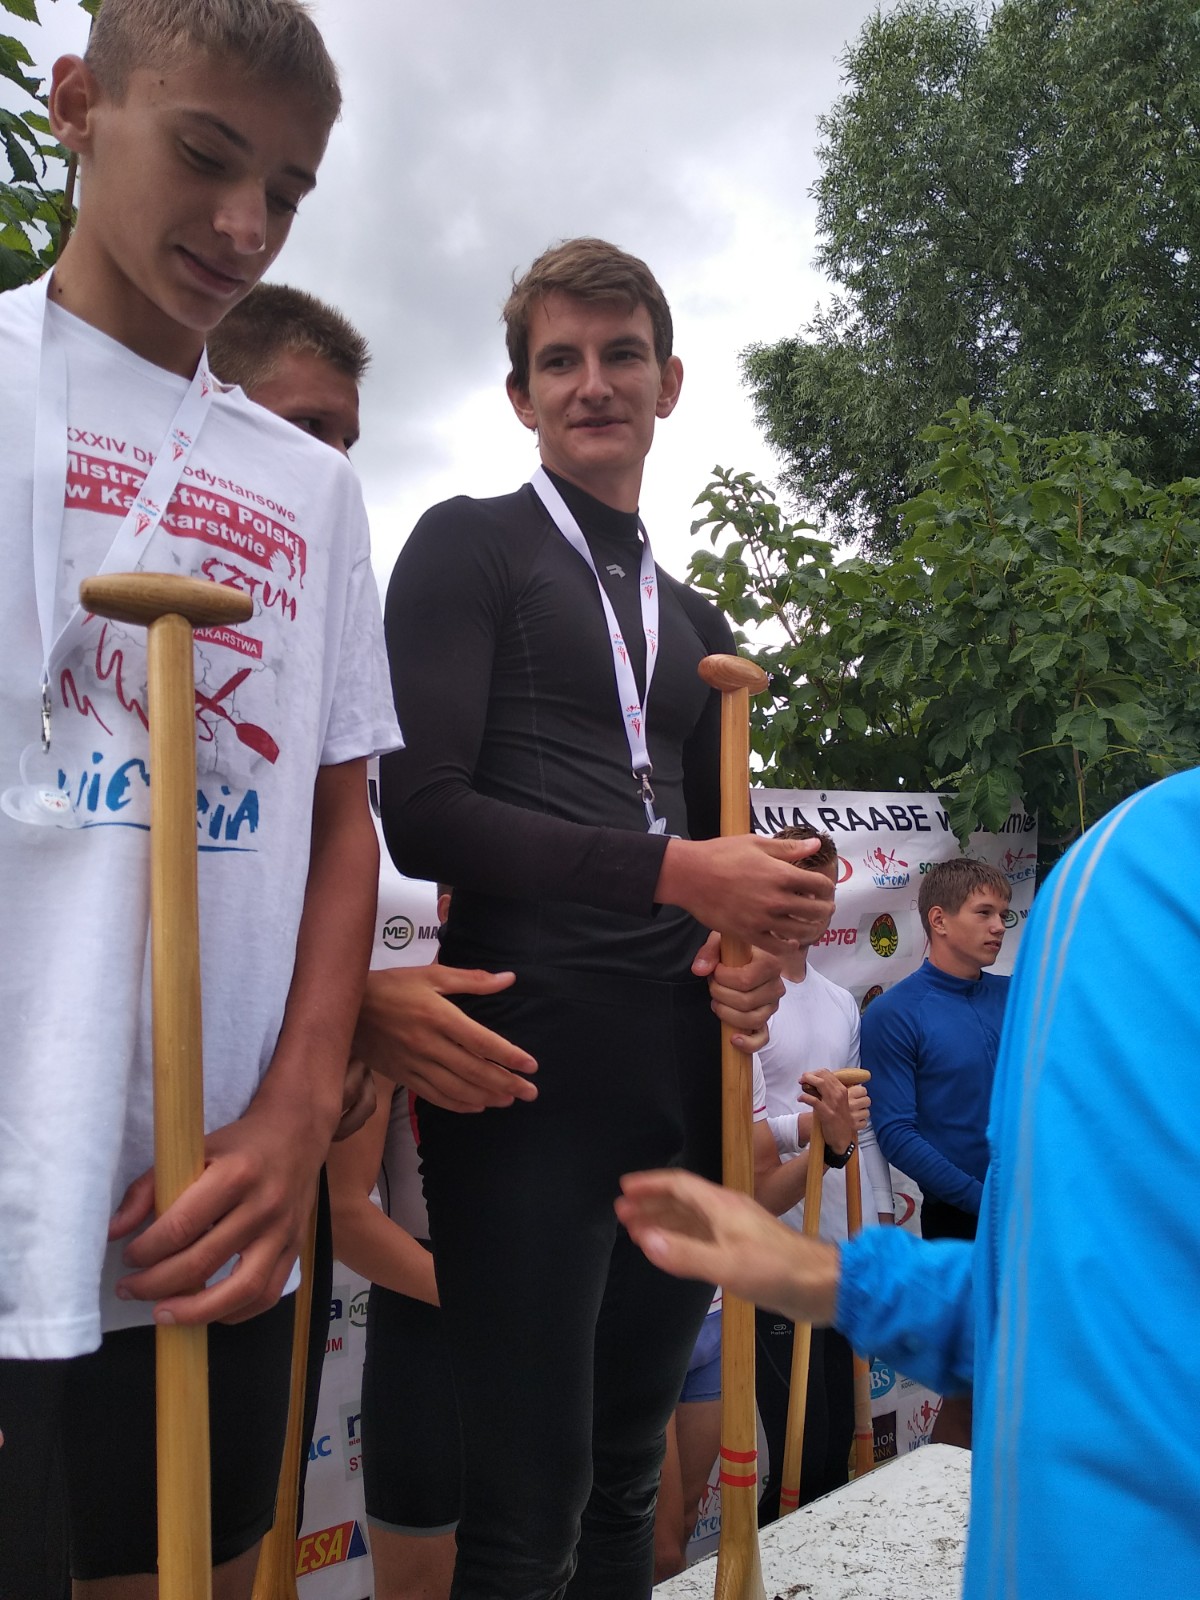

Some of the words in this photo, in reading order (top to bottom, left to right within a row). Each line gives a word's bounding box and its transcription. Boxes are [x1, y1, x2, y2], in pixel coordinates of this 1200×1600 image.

[65, 483, 91, 499] w
[238, 506, 301, 557] Polski
[192, 627, 258, 654] AKARSTWA
[817, 805, 932, 832] RAABE
[870, 1368, 891, 1390] BS
